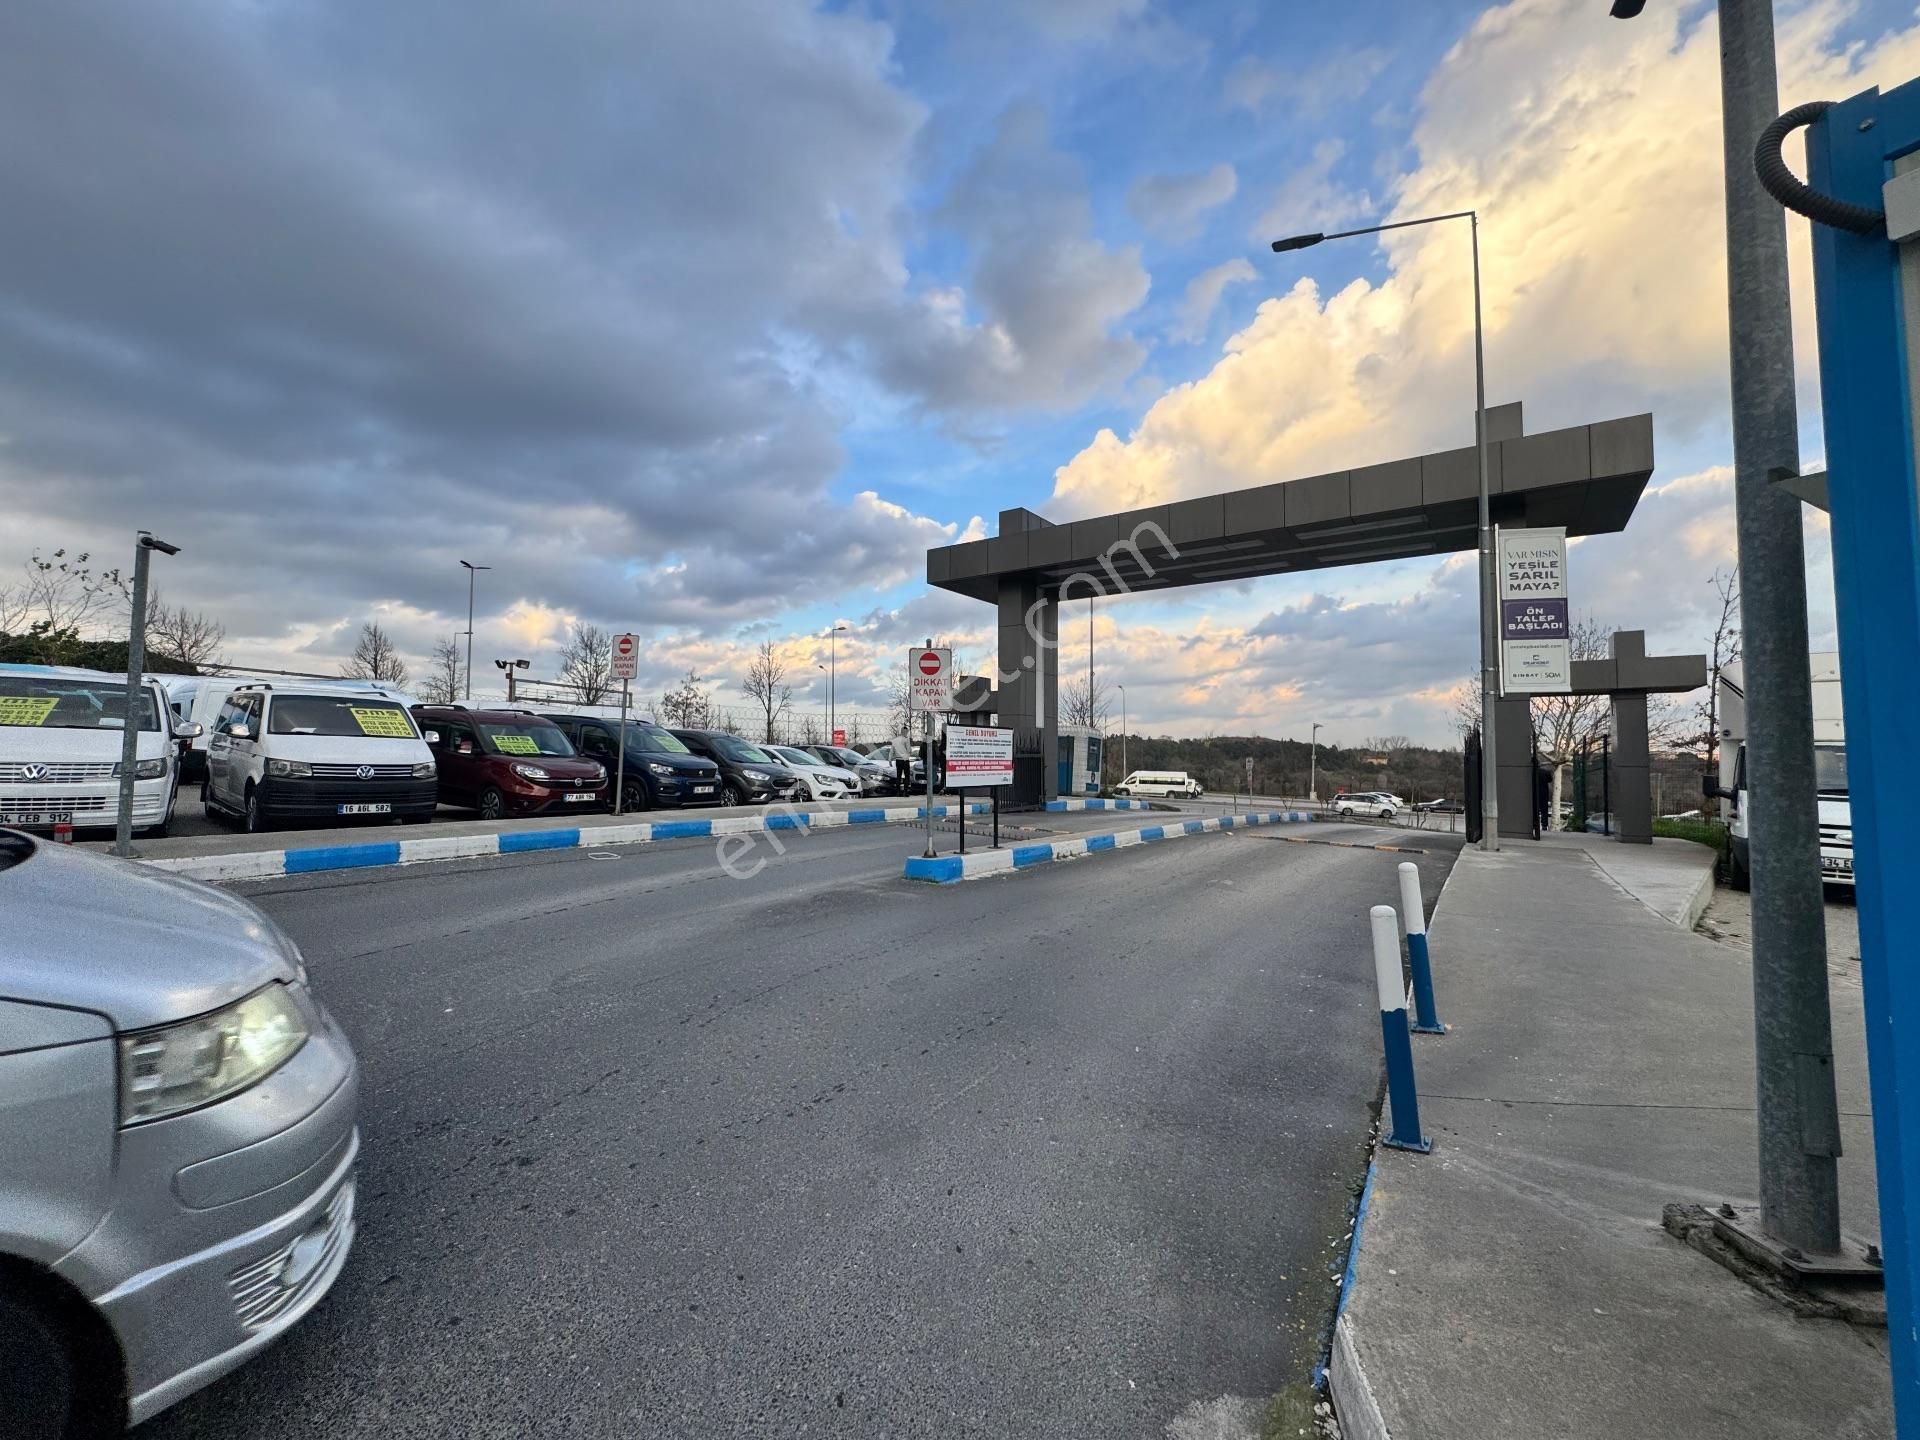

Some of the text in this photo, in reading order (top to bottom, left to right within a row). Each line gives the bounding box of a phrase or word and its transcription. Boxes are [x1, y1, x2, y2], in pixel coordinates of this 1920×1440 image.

[1507, 551, 1527, 559] VAR
[1508, 559, 1559, 571] YEŞİLE
[1508, 571, 1559, 581] SARIL
[1509, 581, 1560, 591] MAYA?
[1526, 606, 1544, 615] ÖN
[1508, 622, 1563, 632] BAŞLADI
[913, 676, 949, 687] DİKKAT
[915, 688, 947, 697] KAPAN
[921, 698, 941, 707] VAR
[345, 805, 354, 813] 16
[357, 805, 371, 813] AGL
[18, 814, 40, 824] CEB
[49, 813, 69, 823] 912
[1826, 858, 1840, 868] 34
